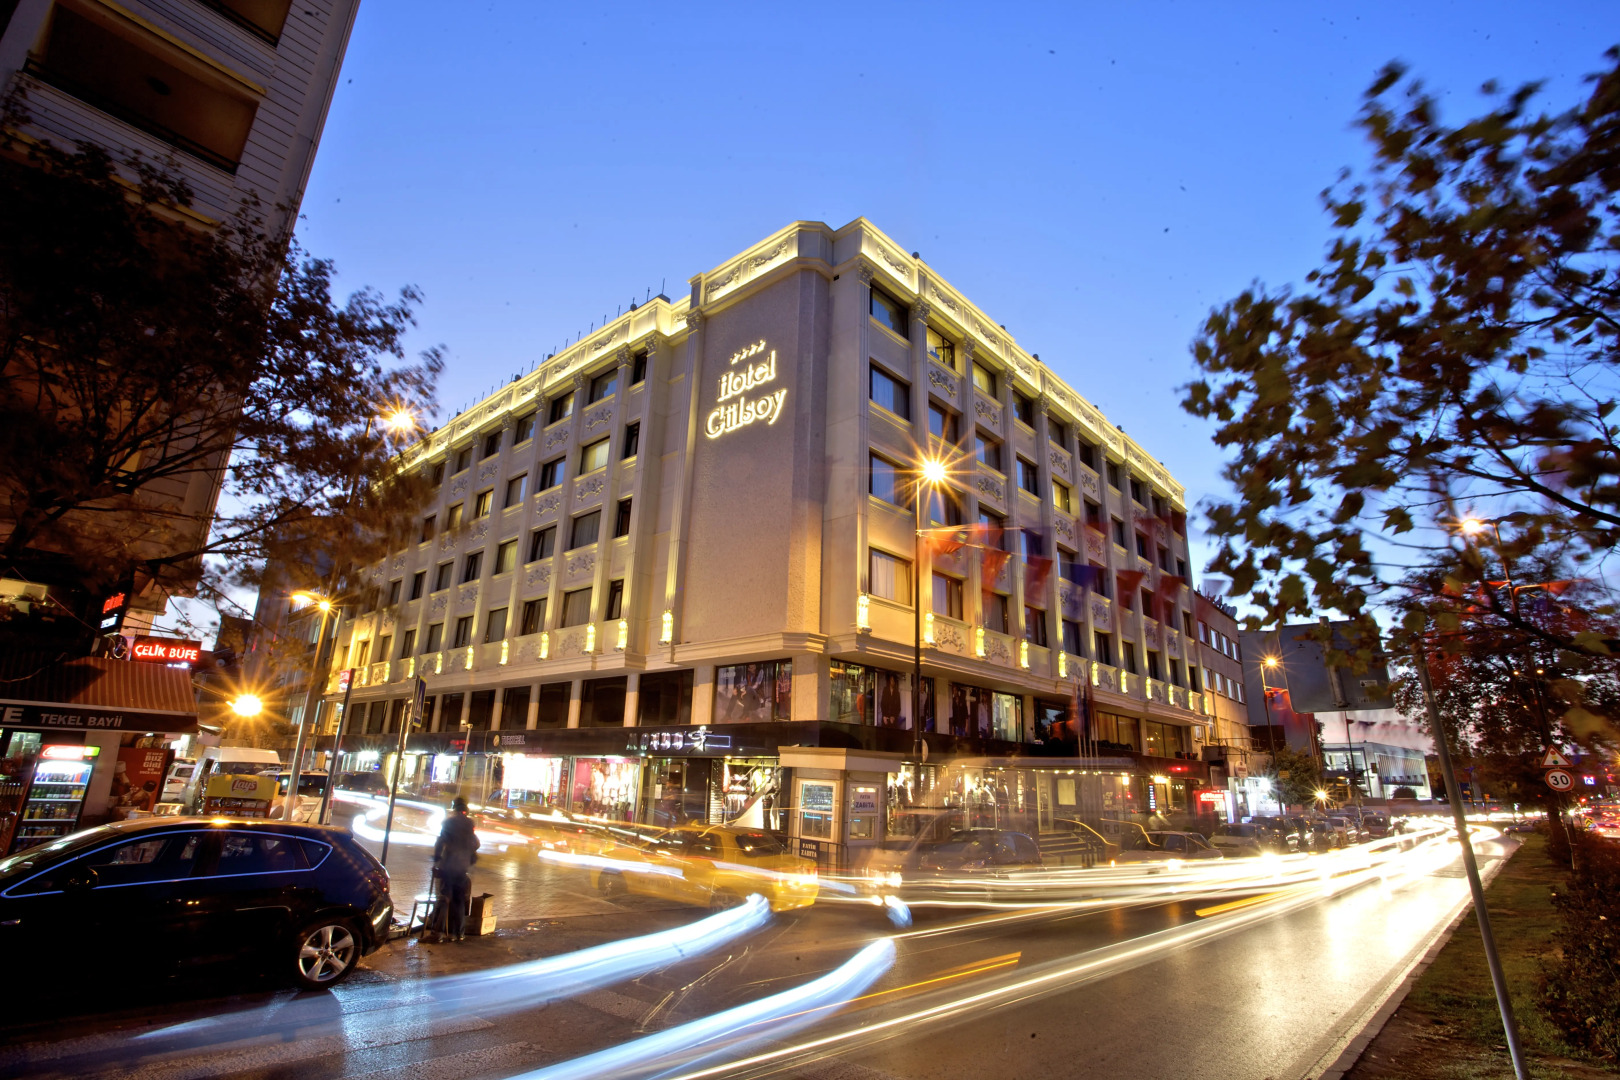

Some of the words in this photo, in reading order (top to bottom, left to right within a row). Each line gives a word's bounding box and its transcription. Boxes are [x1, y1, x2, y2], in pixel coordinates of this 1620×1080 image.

[134, 644, 166, 657] ÇELİK
[168, 647, 198, 661] BÜFE
[40, 713, 83, 725] TEKEL
[1551, 775, 1569, 786] 30
